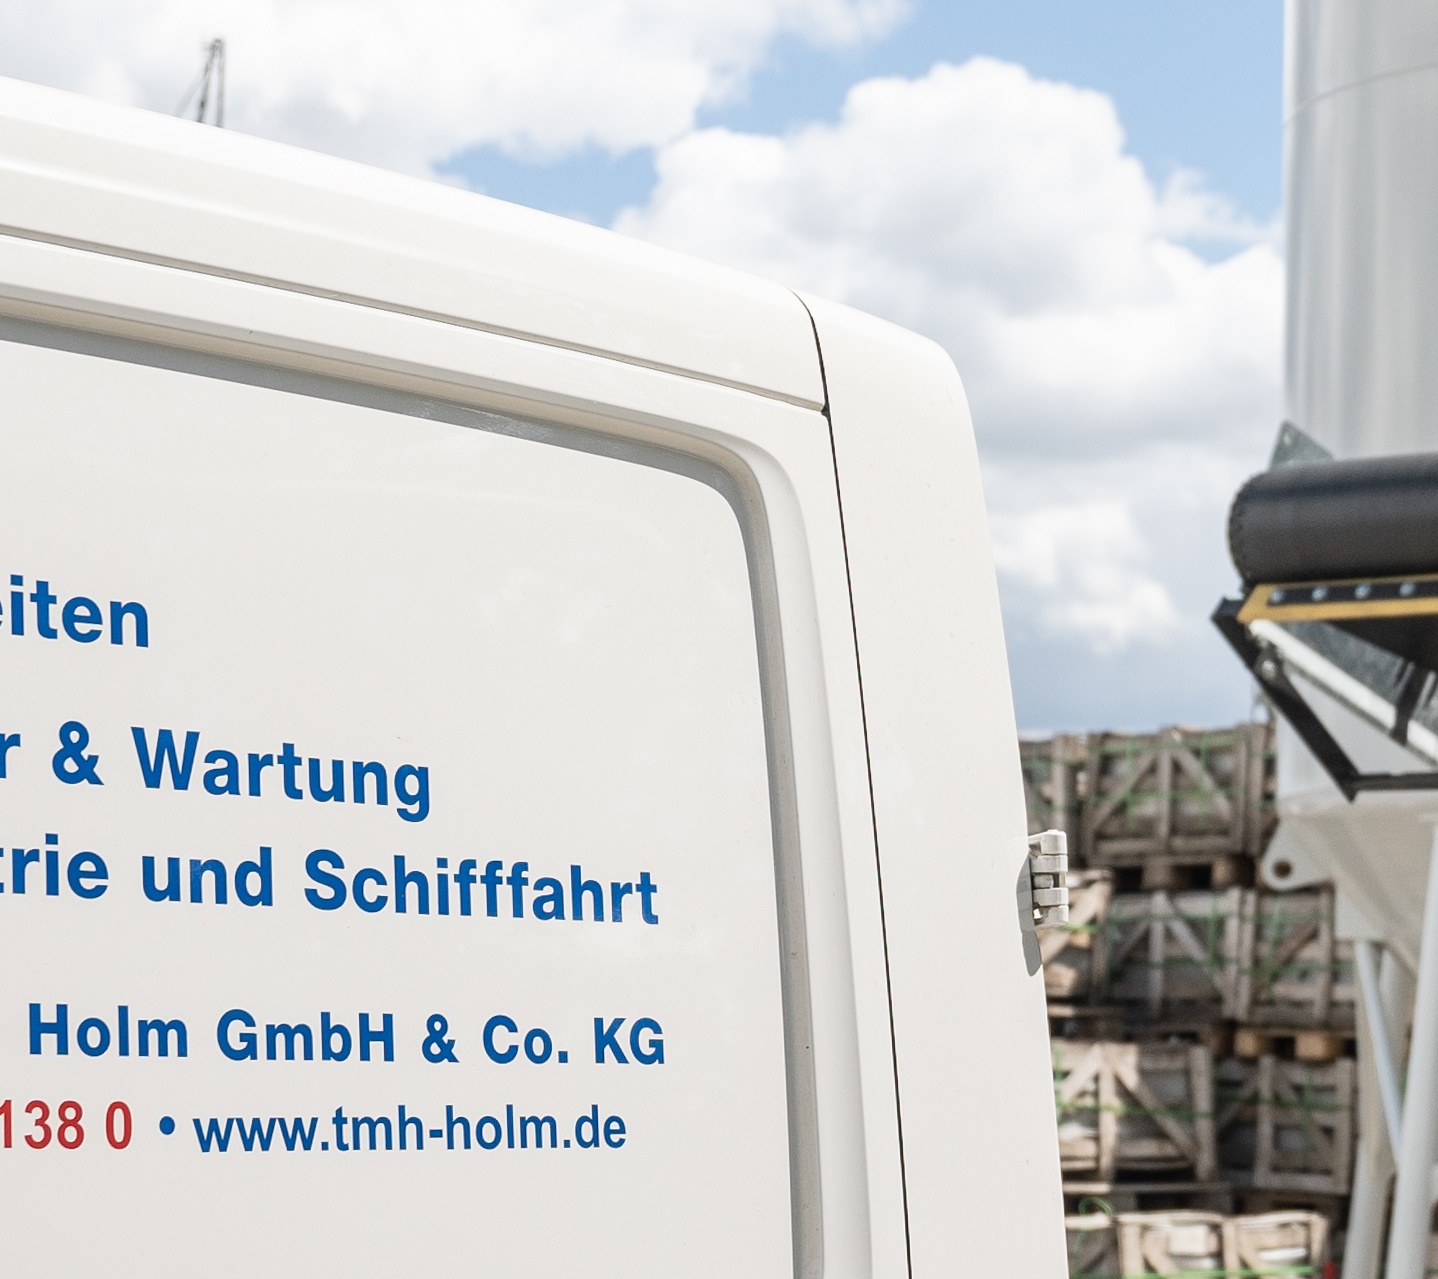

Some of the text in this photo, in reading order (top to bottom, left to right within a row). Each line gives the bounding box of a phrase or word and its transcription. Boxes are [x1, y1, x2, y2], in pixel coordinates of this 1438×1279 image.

[50, 719, 104, 787] &
[130, 725, 431, 824] Wartung
[141, 845, 274, 908] und
[303, 847, 660, 926] Schifffahrt
[27, 1001, 189, 1059] Holm
[216, 1007, 396, 1063] GmbH
[420, 1012, 460, 1065] &
[481, 1013, 570, 1066] Co.
[592, 1016, 666, 1066] KG
[104, 1099, 134, 1152] 0
[192, 1103, 627, 1154] www.tmh-holm.de
